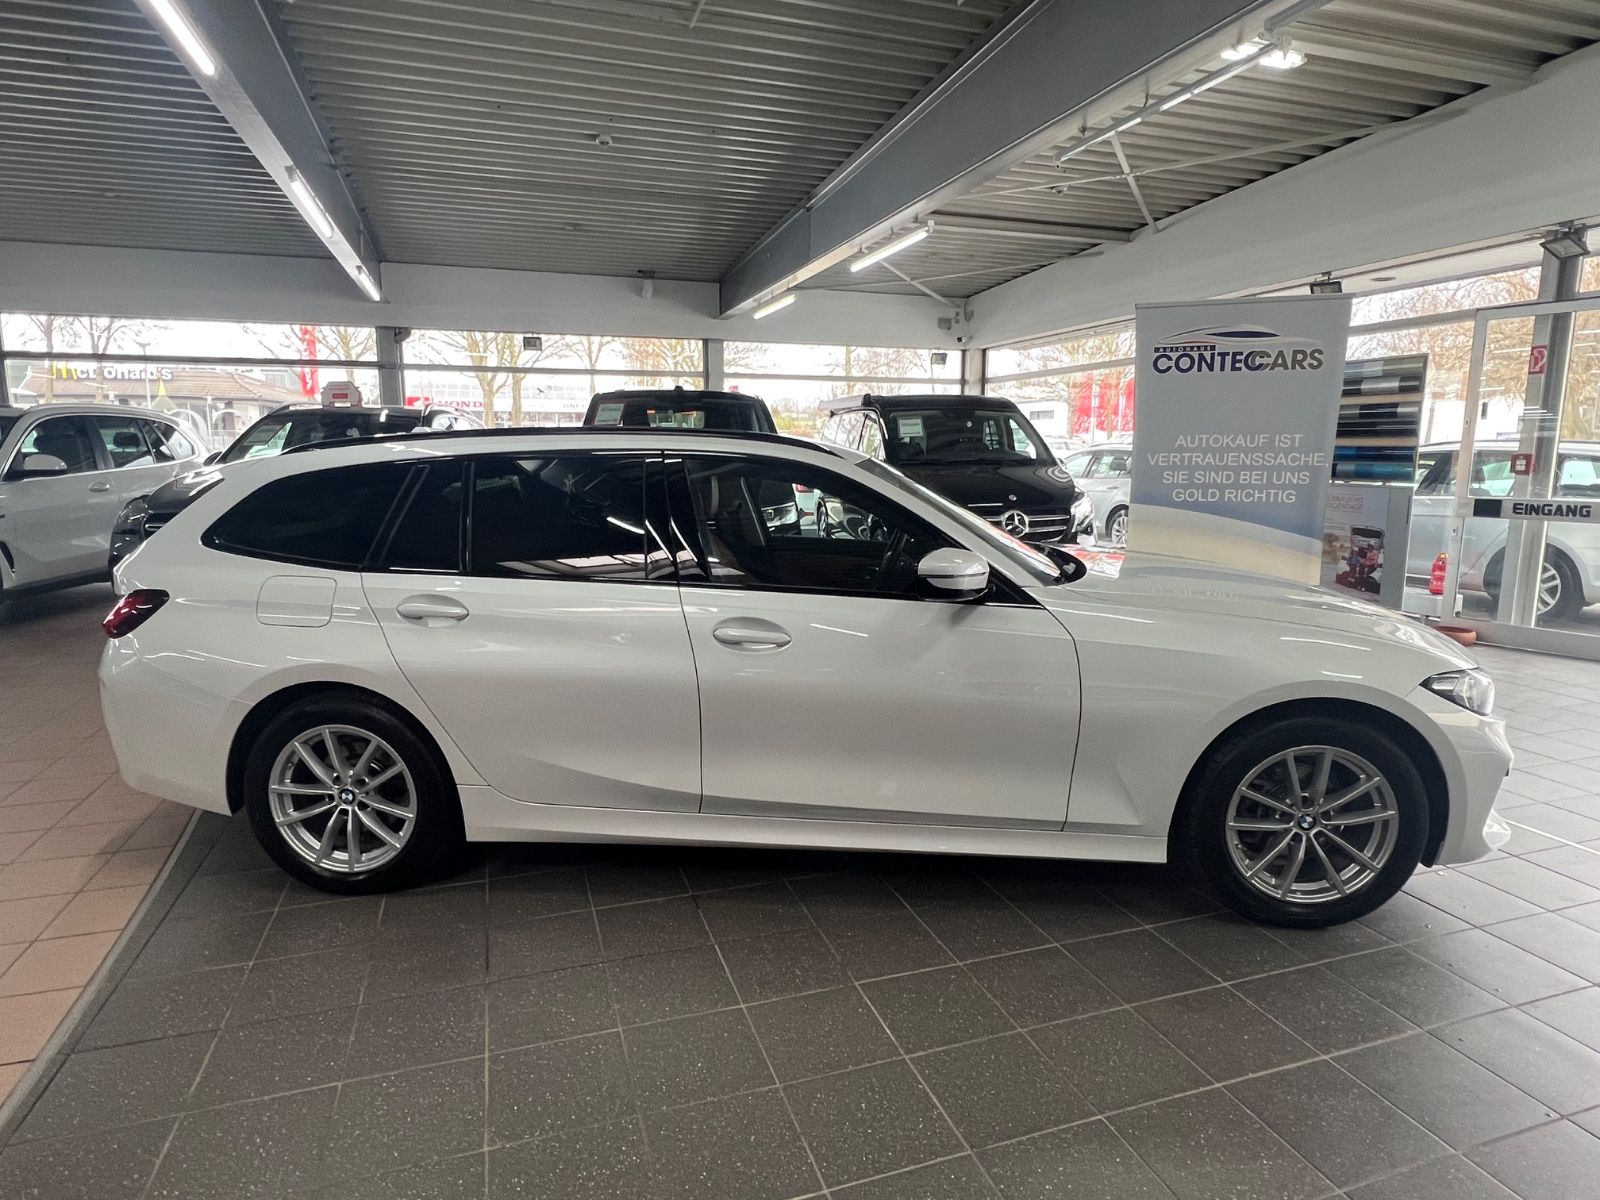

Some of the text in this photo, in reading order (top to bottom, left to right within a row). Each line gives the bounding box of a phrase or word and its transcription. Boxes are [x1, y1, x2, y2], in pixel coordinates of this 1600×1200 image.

[1158, 345, 1213, 353] AUTOHAUS
[1174, 433, 1304, 449] AUTOKAUF IST
[1147, 452, 1330, 468] VERTRAUENSSACHE,
[1162, 470, 1311, 485] SIE SIND BEI UNS
[1172, 488, 1297, 503] GOLD RICHTIG
[1511, 502, 1592, 518] EINGANG
